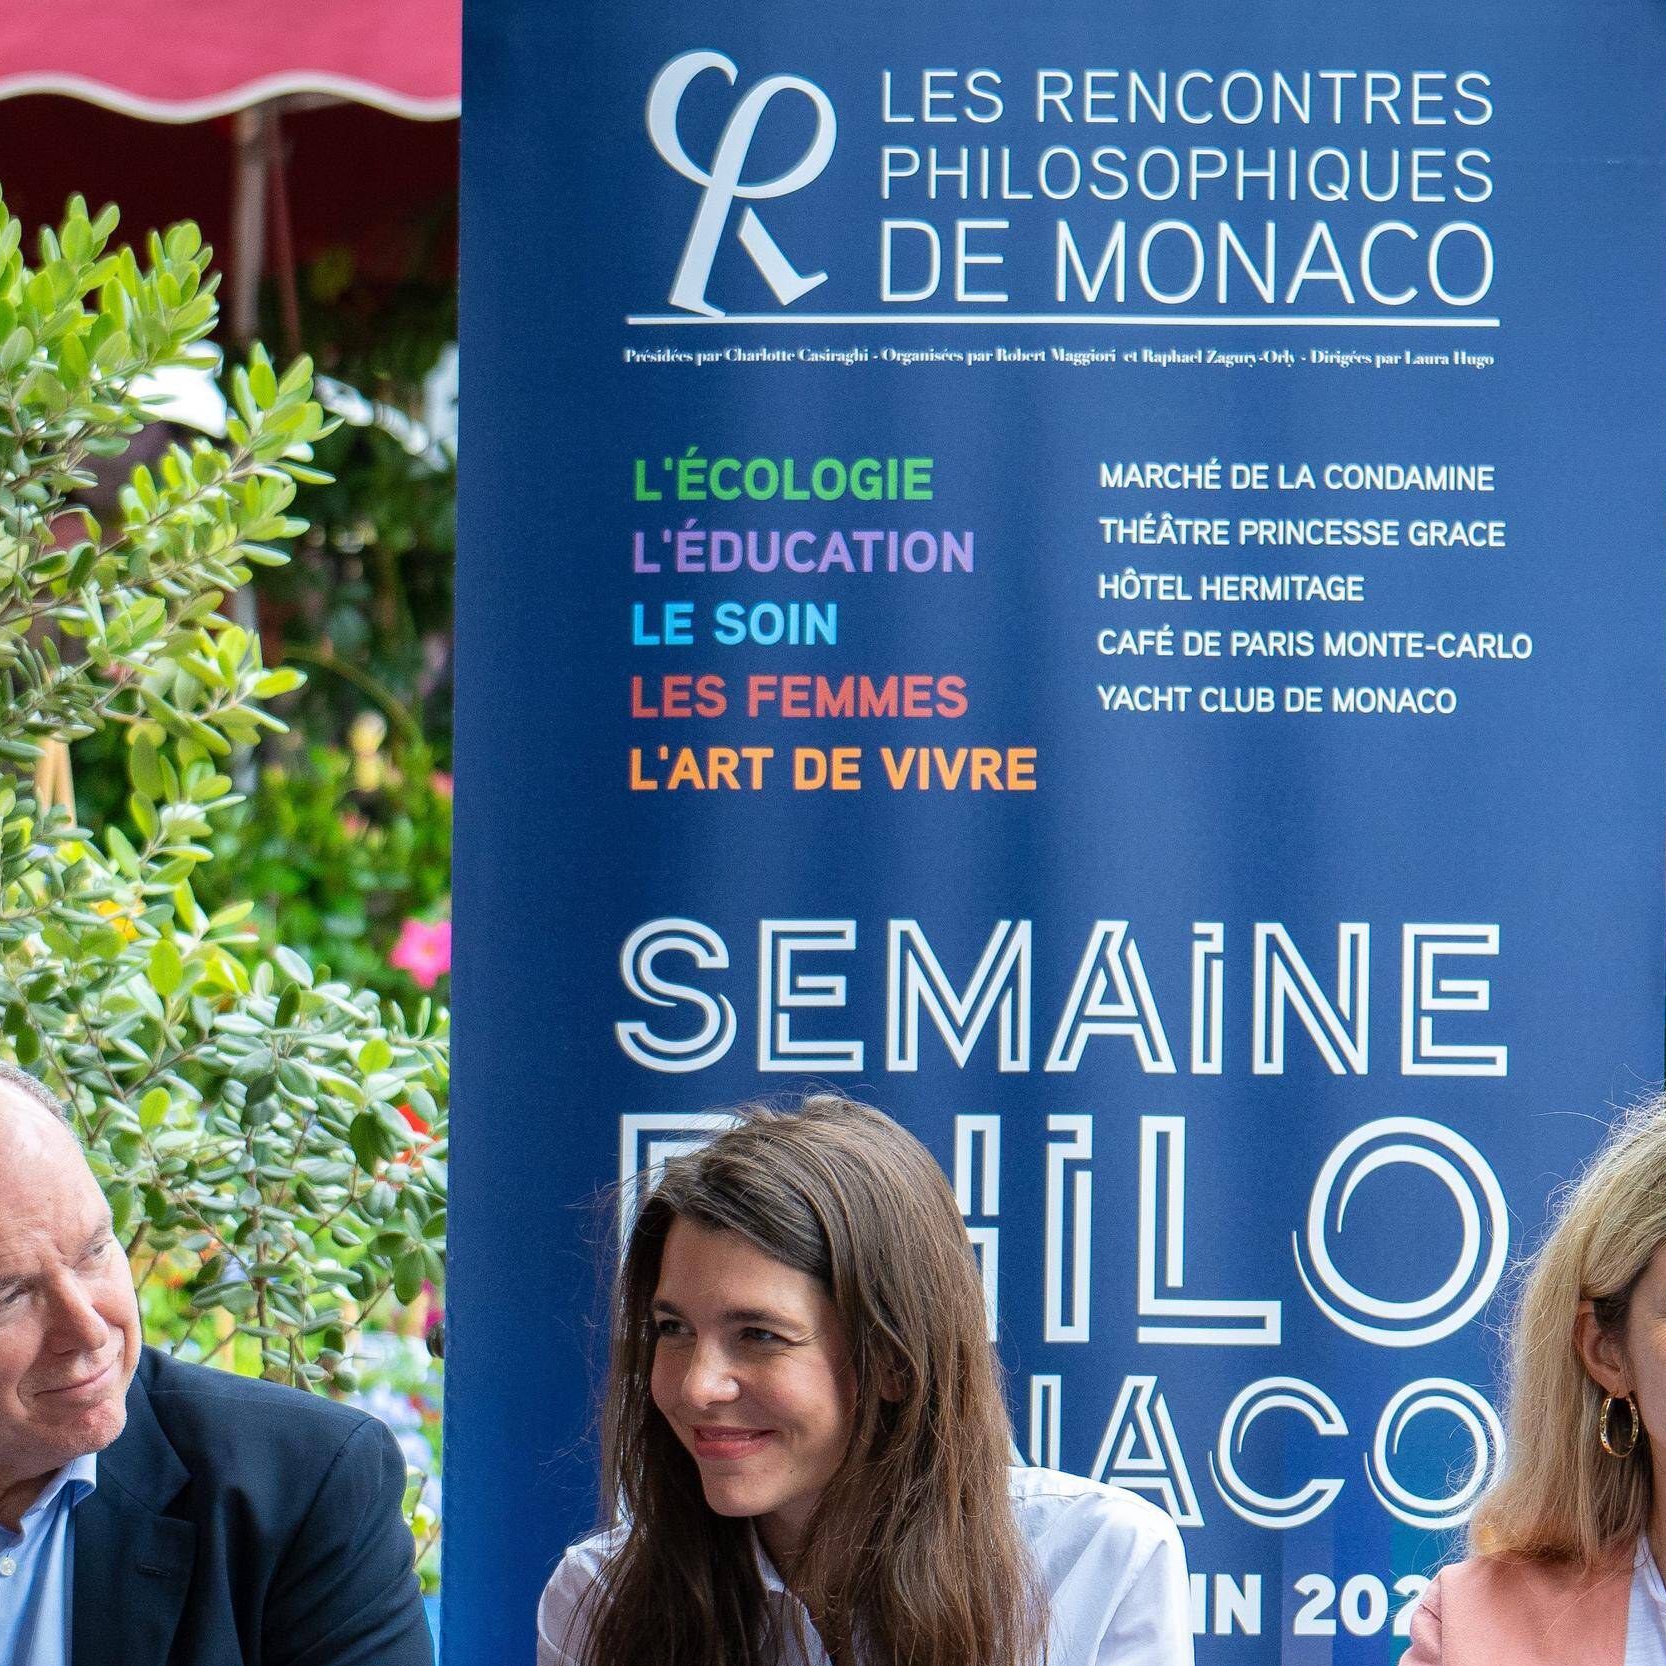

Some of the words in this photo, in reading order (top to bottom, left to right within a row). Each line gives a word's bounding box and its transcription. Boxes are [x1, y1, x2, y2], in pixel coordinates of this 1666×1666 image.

[882, 70, 1004, 125] LES
[1036, 69, 1494, 127] RENCONTRES
[881, 146, 1494, 205] PHILOSOPHIQUES
[880, 219, 1010, 304] DE
[1055, 219, 1495, 307] MONACO
[624, 348, 693, 363] Présidées
[696, 352, 722, 366] par
[726, 348, 795, 363] Charlotte
[799, 348, 869, 366] Casiraghi
[882, 348, 964, 366] Organisées
[966, 352, 993, 366] par
[996, 348, 1046, 363] Robert
[1051, 349, 1117, 366] Maggiori
[1123, 351, 1138, 363] et
[1310, 349, 1372, 368] Dirigées
[1375, 352, 1401, 368] par
[1404, 350, 1450, 365] Laura
[1453, 350, 1495, 369] Hugo
[635, 446, 934, 501] L'ÉCOLOGIE
[1100, 457, 1222, 492] MARCHÉ
[1231, 464, 1269, 491] DE
[1279, 464, 1316, 491] LA
[1323, 464, 1495, 493] CONDAMINE
[634, 518, 975, 573] L'ÉDUCATION
[1099, 512, 1231, 547] THÉÂTRE
[1239, 519, 1400, 547] PRINCESSE
[1408, 520, 1506, 548] GRACE
[1098, 567, 1193, 601] HÔTEL
[1201, 574, 1365, 603] HERMITAGE
[633, 603, 695, 646] LE
[714, 602, 838, 647] SOIN
[1098, 623, 1174, 656] CAFÉ
[1182, 630, 1222, 657] DE
[1230, 631, 1315, 657] PARIS
[1323, 631, 1533, 660] MONTE-CARLO
[630, 674, 728, 719] LES
[748, 674, 970, 719] FEMMES
[1097, 685, 1193, 712] YACHT
[1200, 687, 1275, 713] CLUB
[1284, 687, 1324, 714] DE
[1332, 687, 1457, 714] MONACO
[629, 745, 774, 791] L'ART
[793, 747, 863, 791] DE
[880, 747, 1038, 791] VIVRE
[1030, 1373, 1506, 1531] ACO
[1190, 1572, 1263, 1636] IN
[1292, 1572, 1434, 1637] 202
